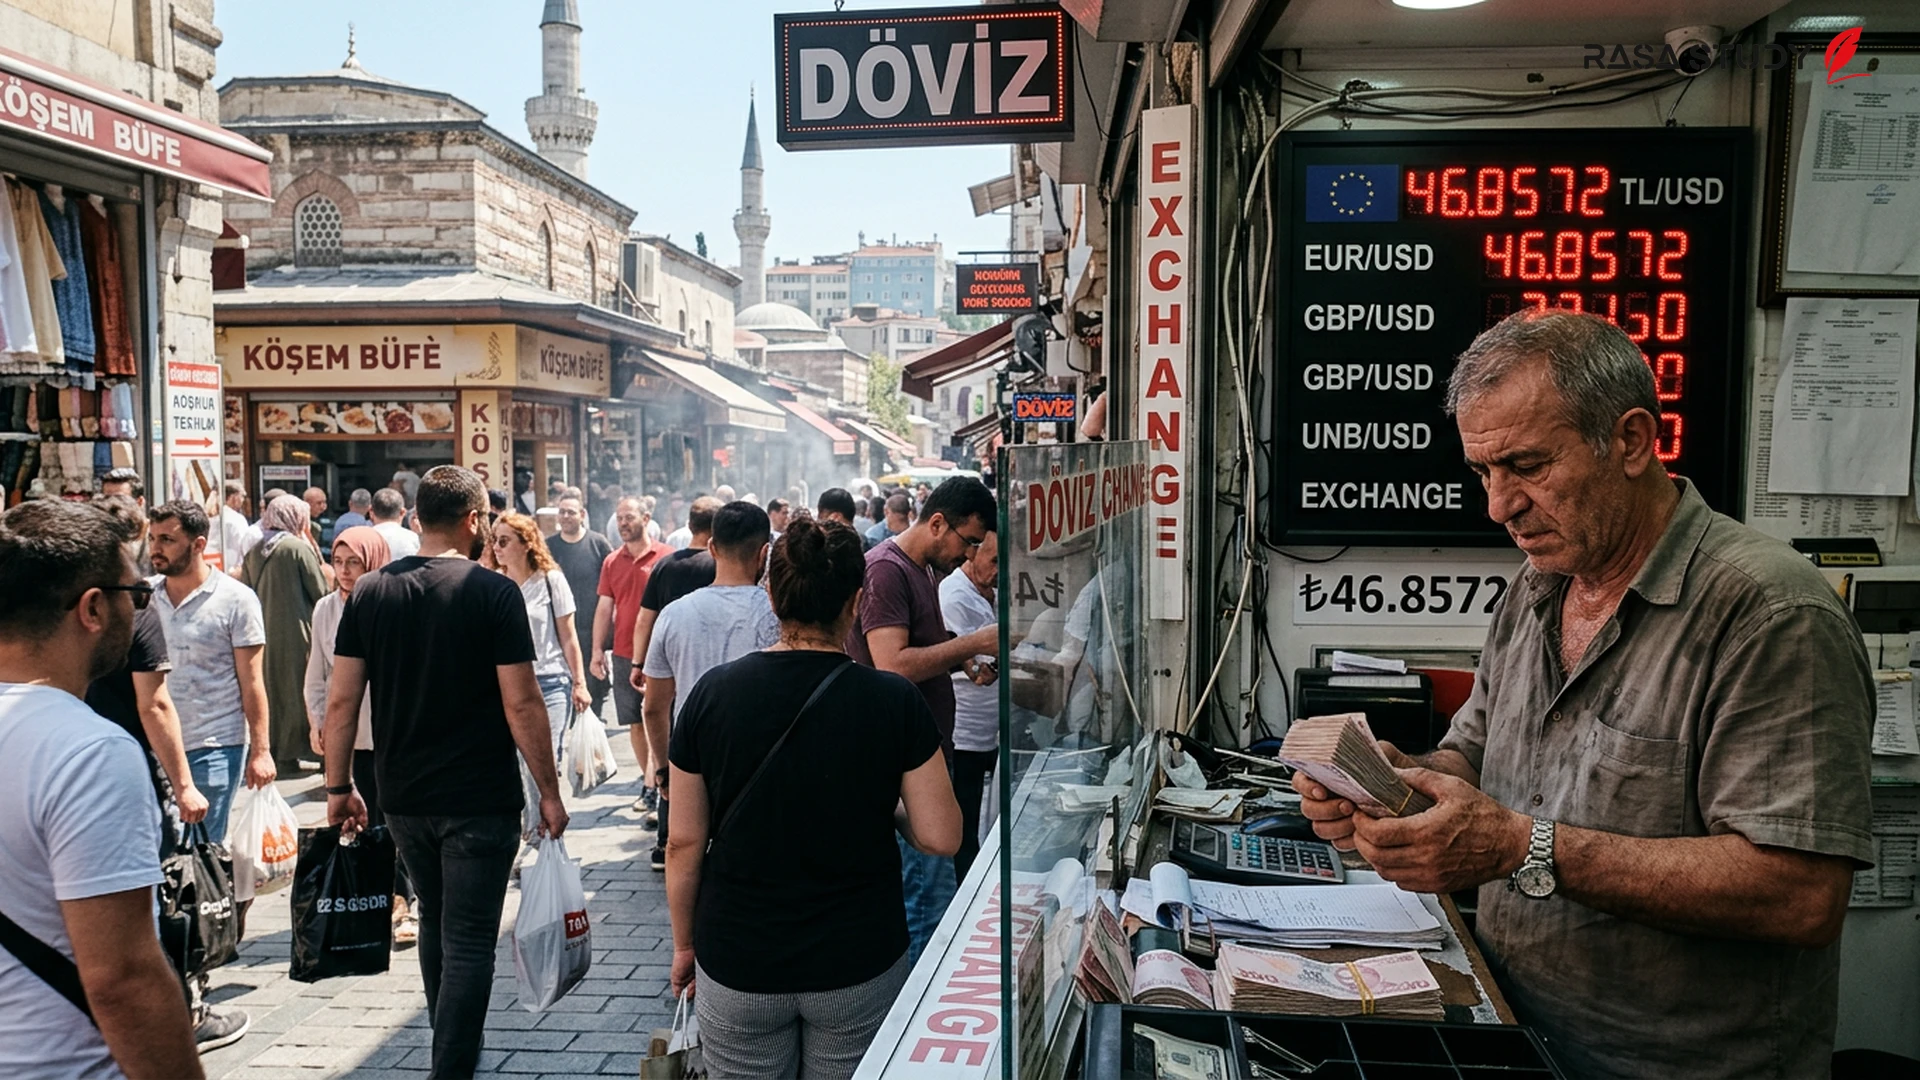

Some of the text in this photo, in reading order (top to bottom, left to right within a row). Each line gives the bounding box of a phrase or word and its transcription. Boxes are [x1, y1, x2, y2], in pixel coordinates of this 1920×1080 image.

[799, 23, 1051, 121] DÖVİZ
[113, 120, 182, 167] BÜFE
[1405, 166, 1724, 218] 46.8572 TL/USD
[1304, 230, 1689, 281] EUR/USD 46.8572
[1303, 303, 1436, 332] GBP/USD
[243, 337, 350, 376] KÖŞEM
[1147, 141, 1184, 559] EXCHANGE
[1302, 363, 1434, 391] GBP/USD
[1302, 422, 1432, 450] UNB/USD
[1028, 457, 1096, 552] DÖVİZ
[1301, 481, 1463, 509] EXCHANGE
[1299, 573, 1508, 614] ₺46.8572
